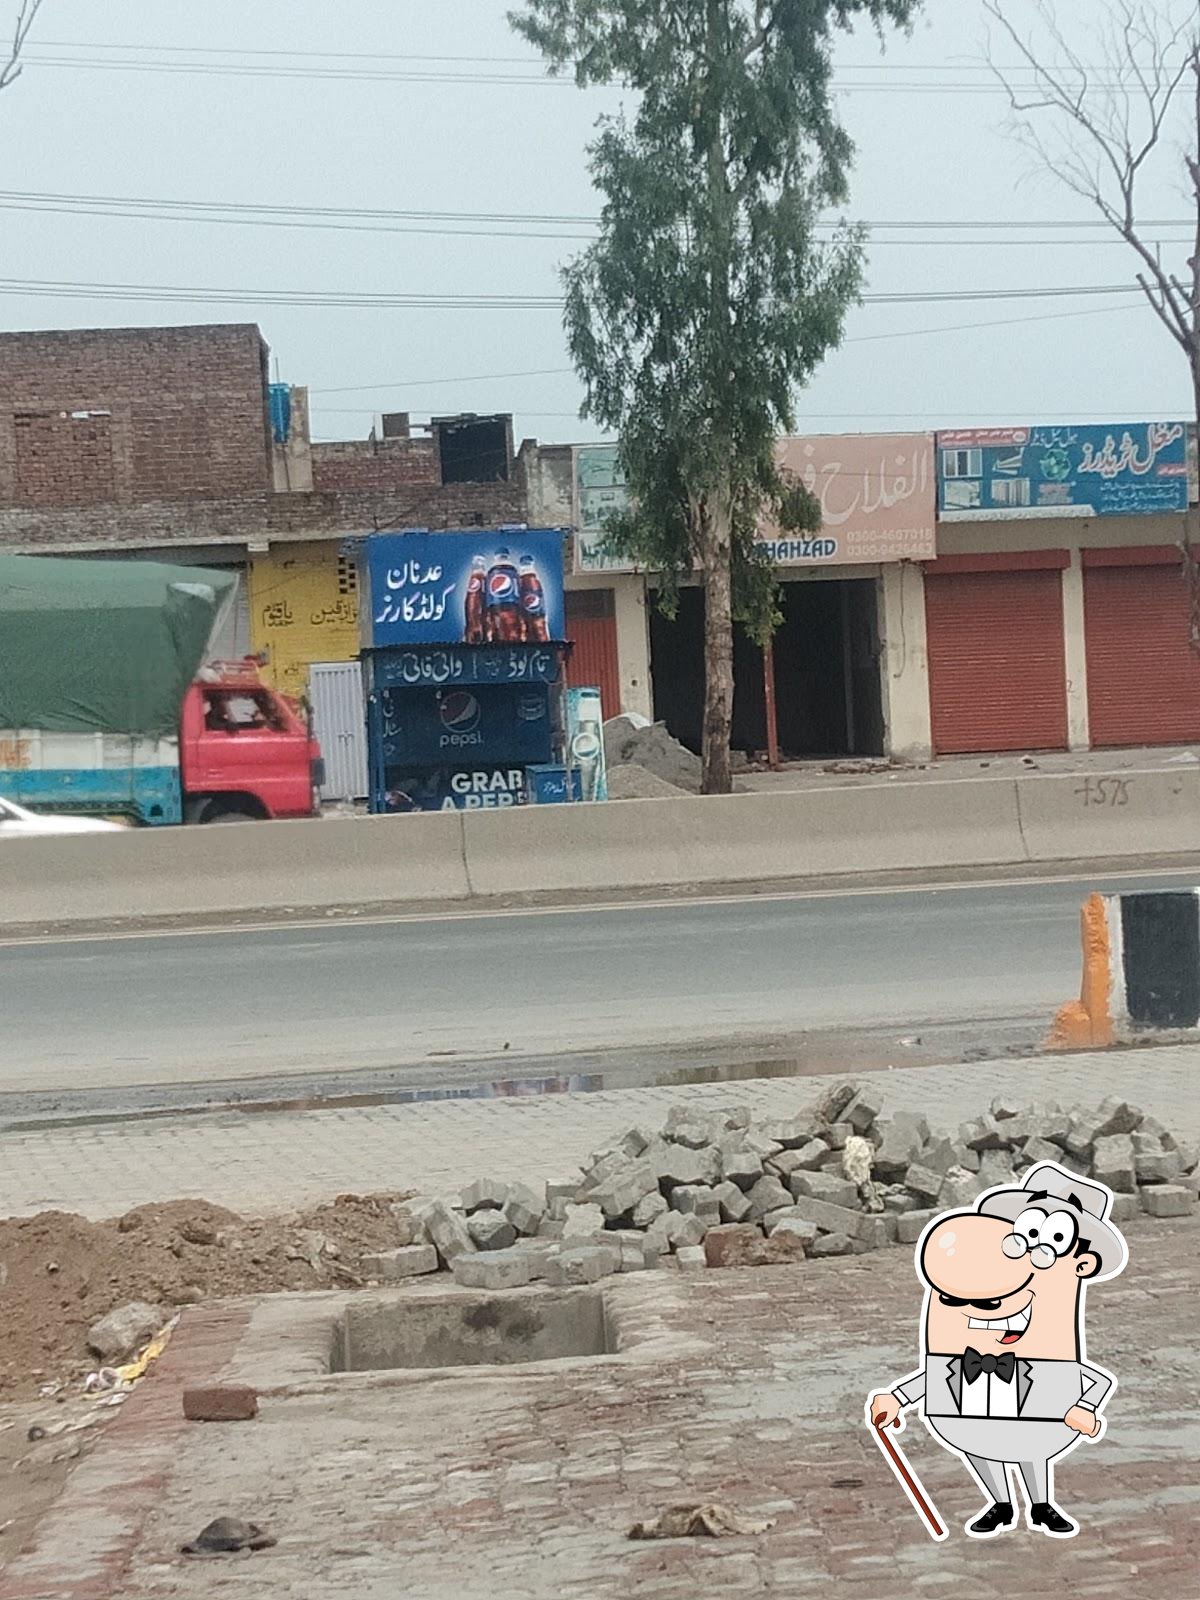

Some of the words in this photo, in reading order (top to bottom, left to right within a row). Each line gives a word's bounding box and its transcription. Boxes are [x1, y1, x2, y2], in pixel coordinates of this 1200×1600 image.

[820, 450, 928, 525] الفلاح
[386, 559, 442, 590] عدنان
[440, 730, 482, 749] pepsi
[451, 769, 523, 793] GRAB
[441, 795, 457, 811] A
